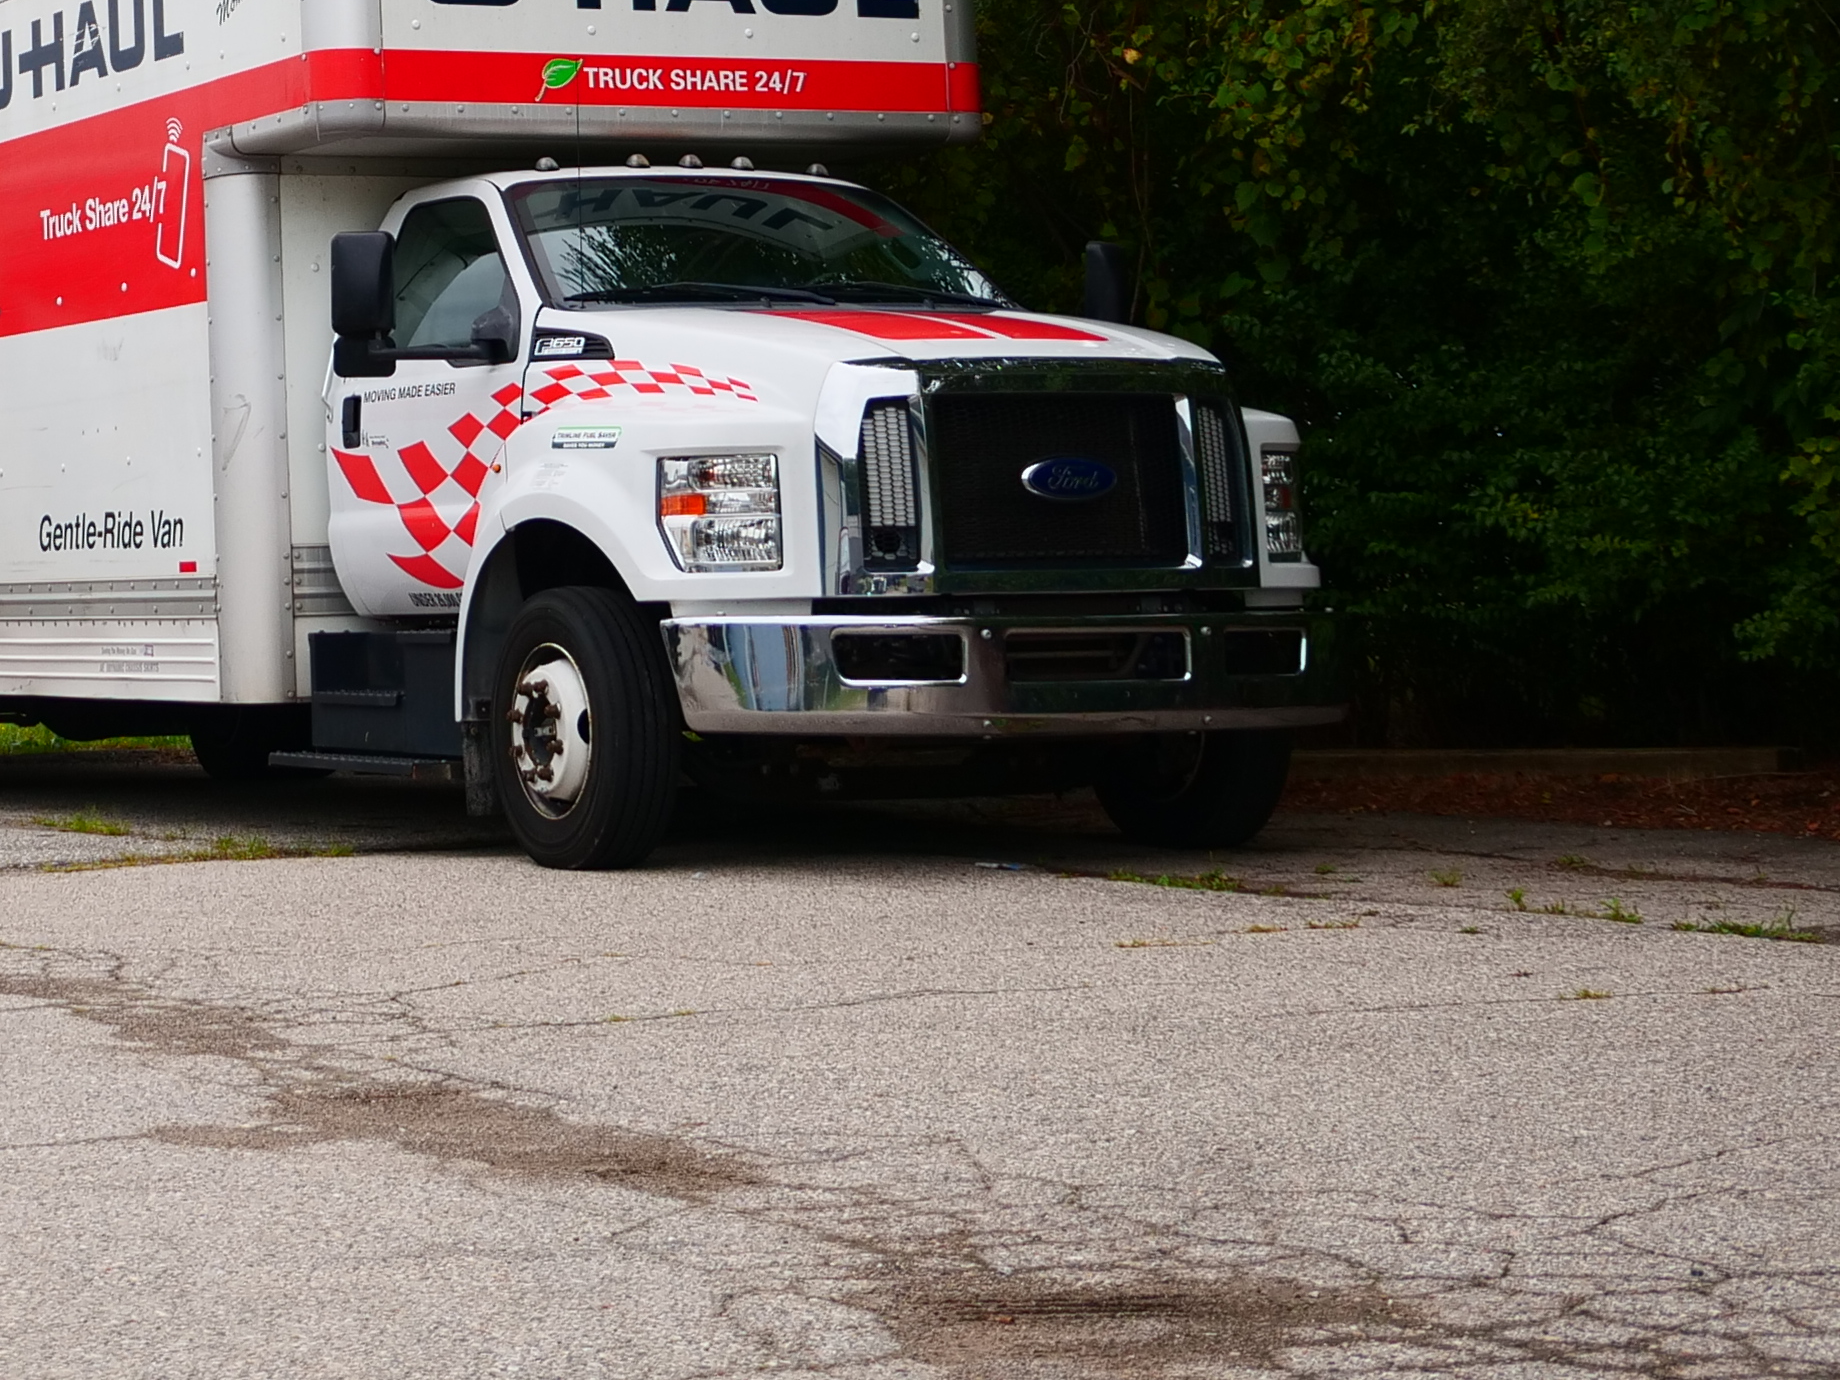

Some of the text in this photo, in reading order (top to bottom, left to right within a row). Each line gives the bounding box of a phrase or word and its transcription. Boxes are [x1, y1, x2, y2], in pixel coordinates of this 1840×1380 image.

[583, 67, 807, 95] TRUCK SHARE 24/7
[40, 175, 167, 240] Truck Share 24/7
[363, 382, 456, 404] MOVING MADE EASIER
[1047, 465, 1100, 490] Ford
[39, 509, 184, 552] Gentle-Ride Van
